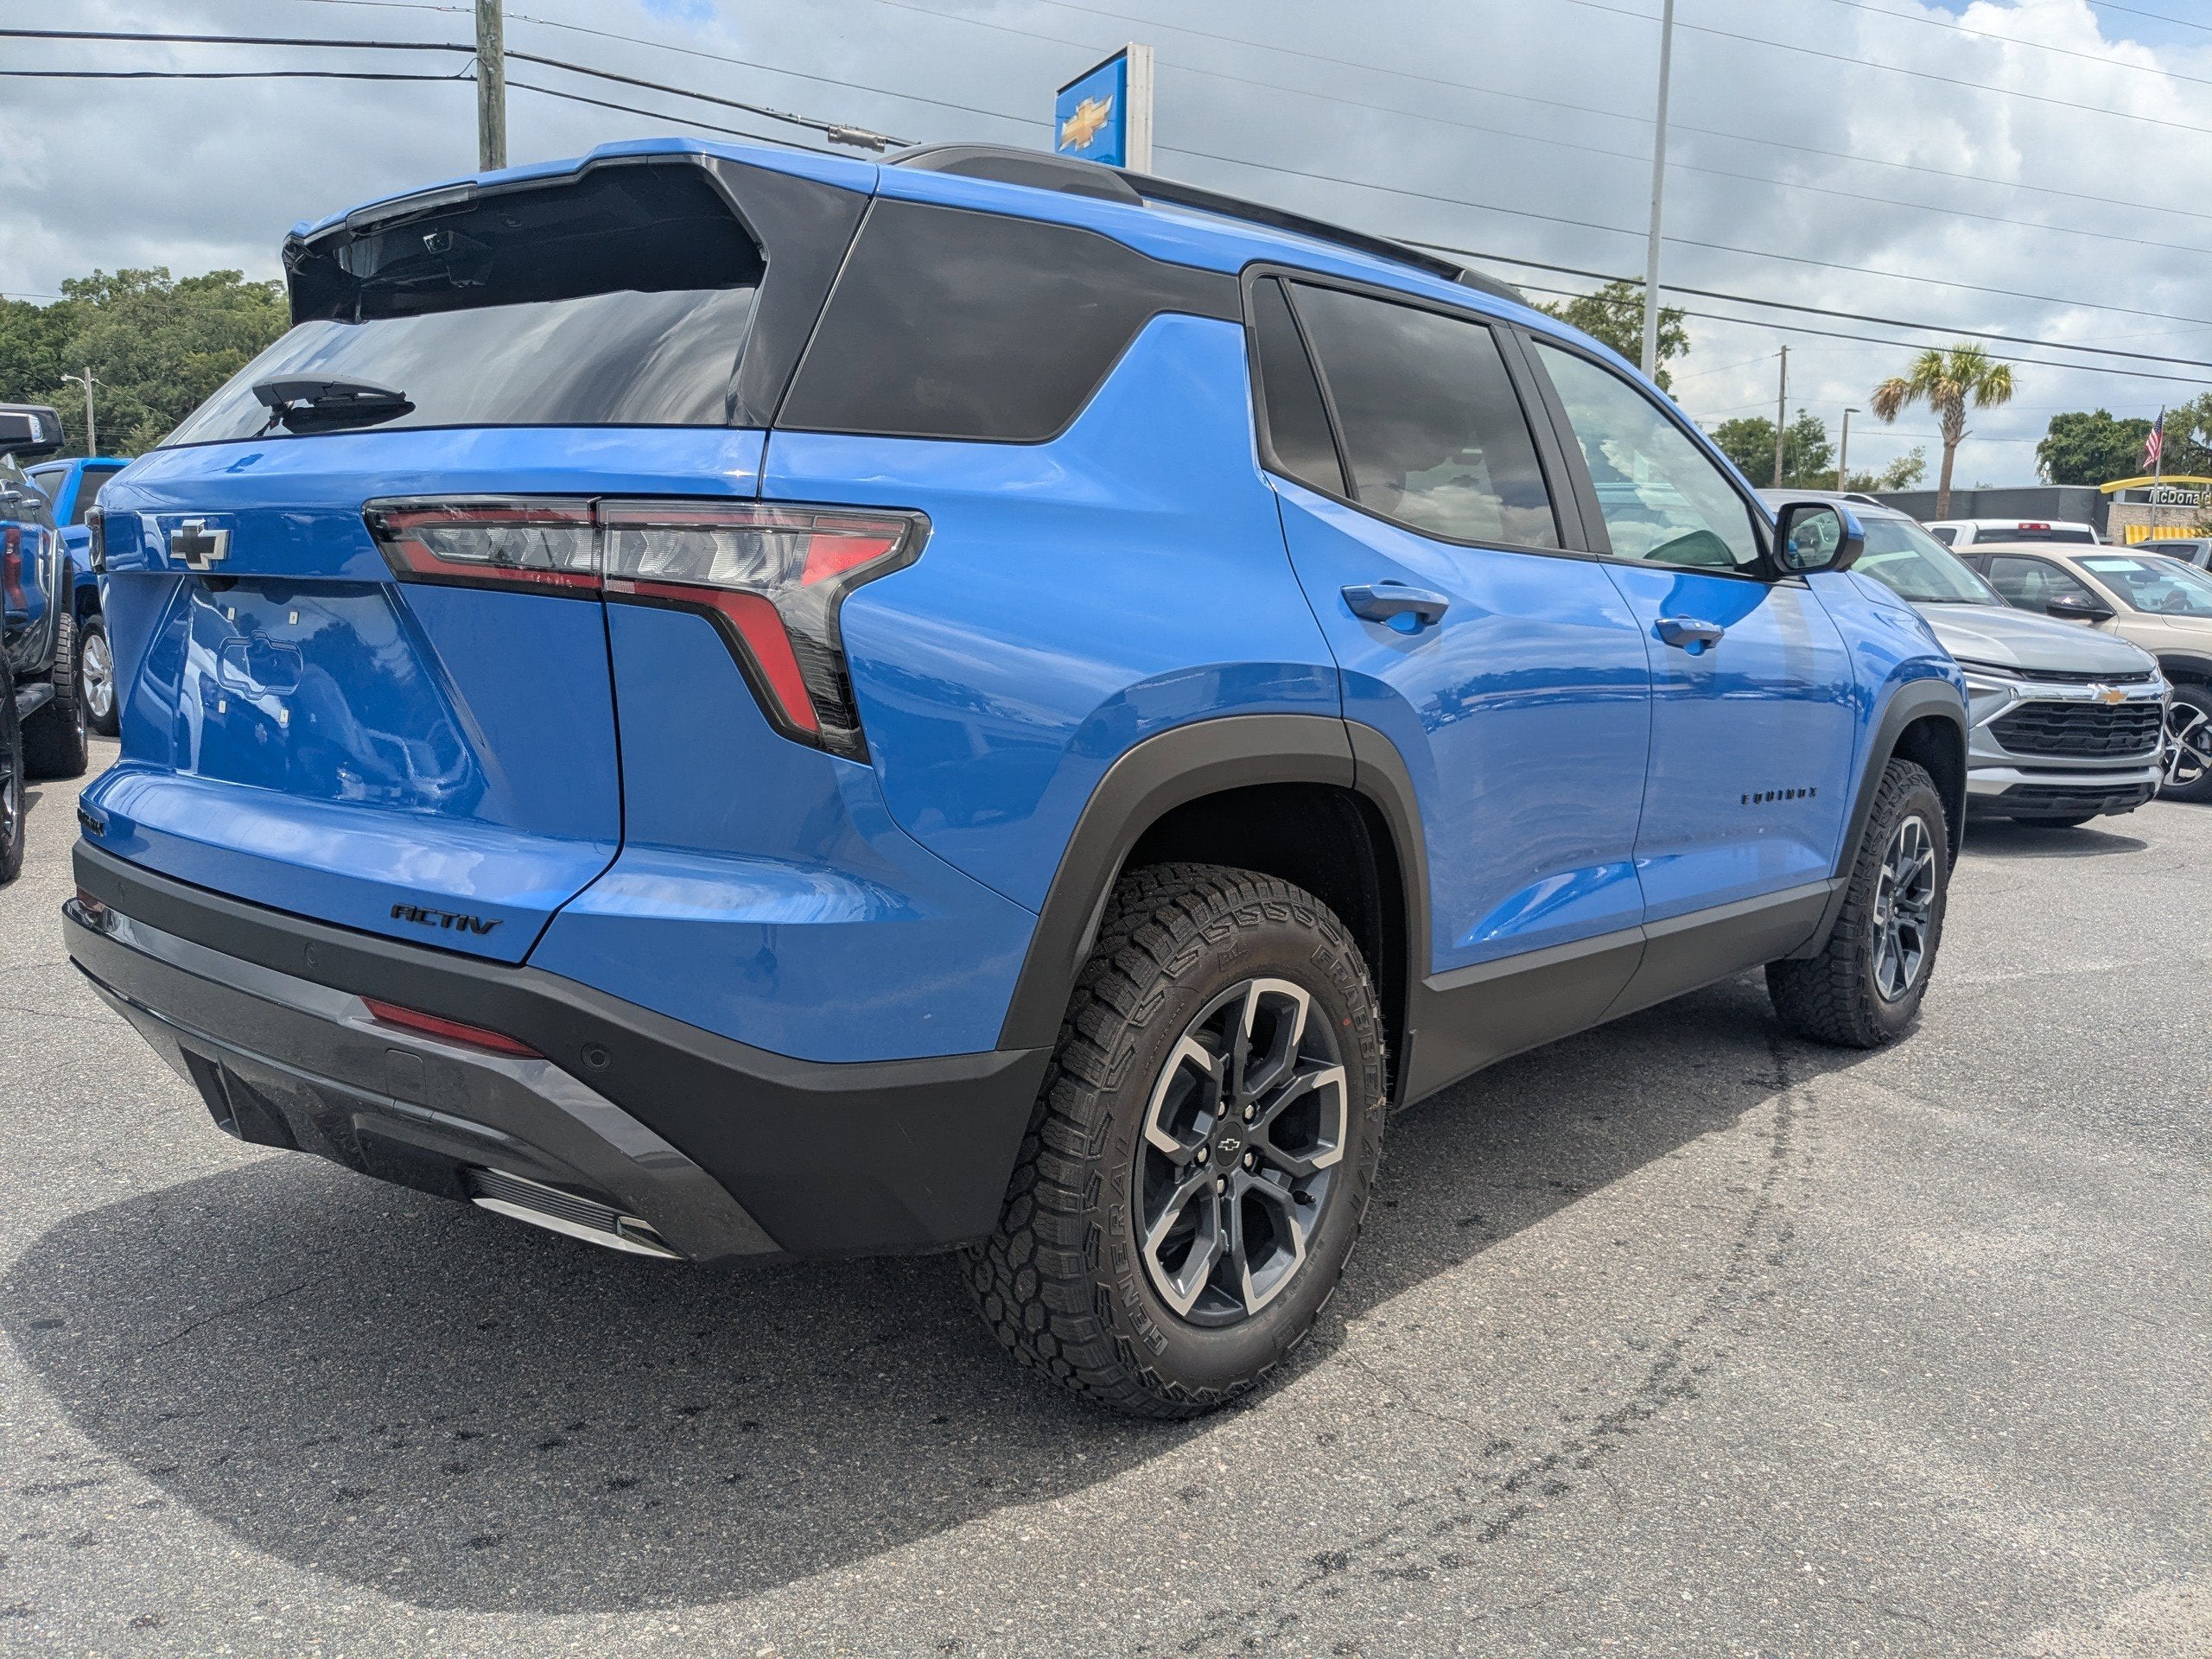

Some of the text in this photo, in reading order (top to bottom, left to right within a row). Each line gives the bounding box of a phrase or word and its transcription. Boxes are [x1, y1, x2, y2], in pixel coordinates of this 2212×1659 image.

[1740, 786, 1817, 805] EQUINOX
[391, 903, 504, 934] ACTIV
[1109, 1136, 1168, 1357] GENERAL
